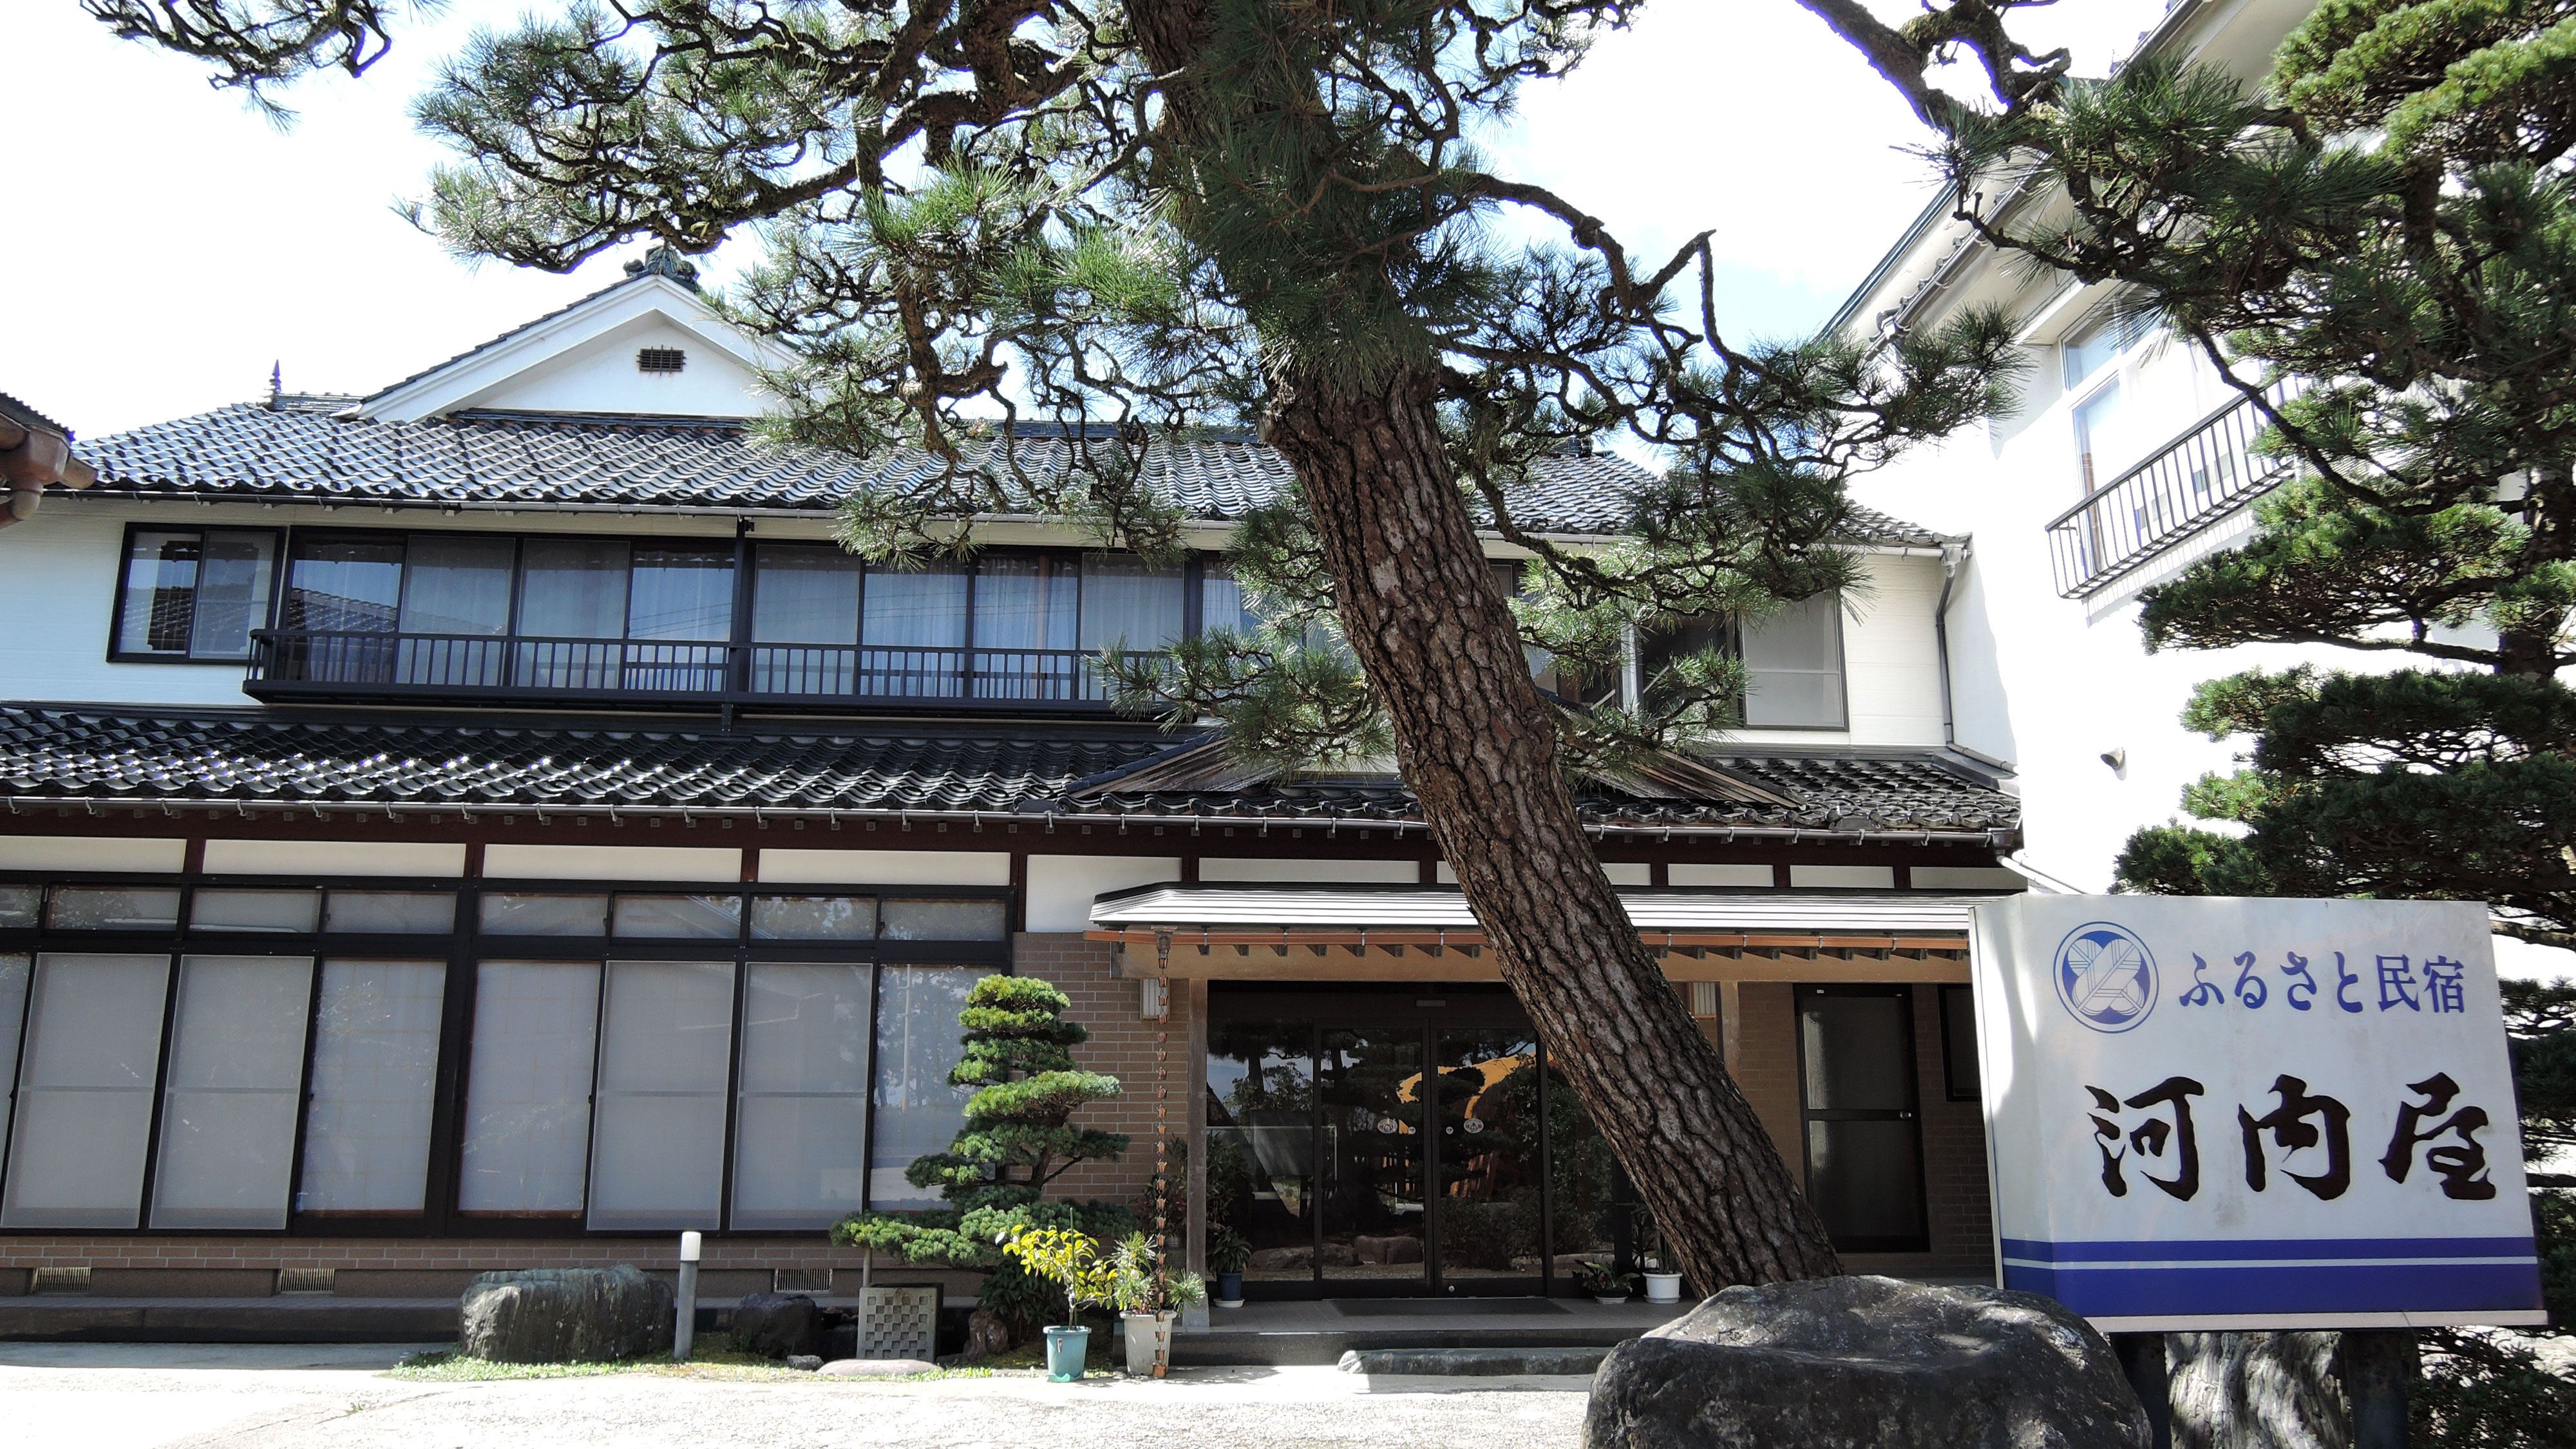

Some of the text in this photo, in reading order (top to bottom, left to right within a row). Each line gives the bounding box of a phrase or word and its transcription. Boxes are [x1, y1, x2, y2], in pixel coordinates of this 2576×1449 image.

[2179, 951, 2465, 1014] ふるさと民宿
[2084, 1072, 2497, 1202] 河内屋
